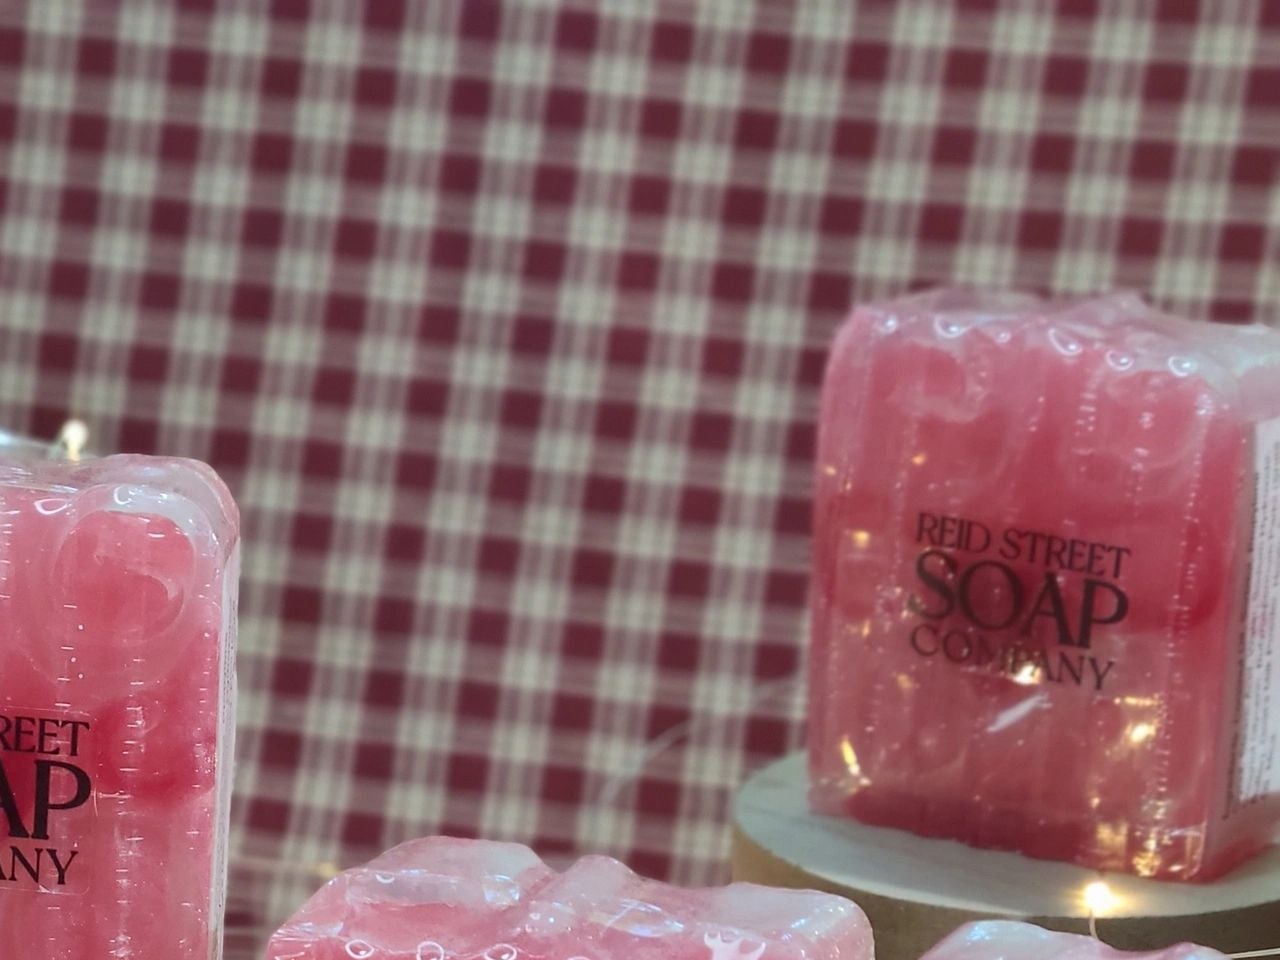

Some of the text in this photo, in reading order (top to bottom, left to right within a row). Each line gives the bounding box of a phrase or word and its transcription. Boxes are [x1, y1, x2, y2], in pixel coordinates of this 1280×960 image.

[916, 512, 1132, 578] REID STREET
[906, 550, 1129, 648] SOAP
